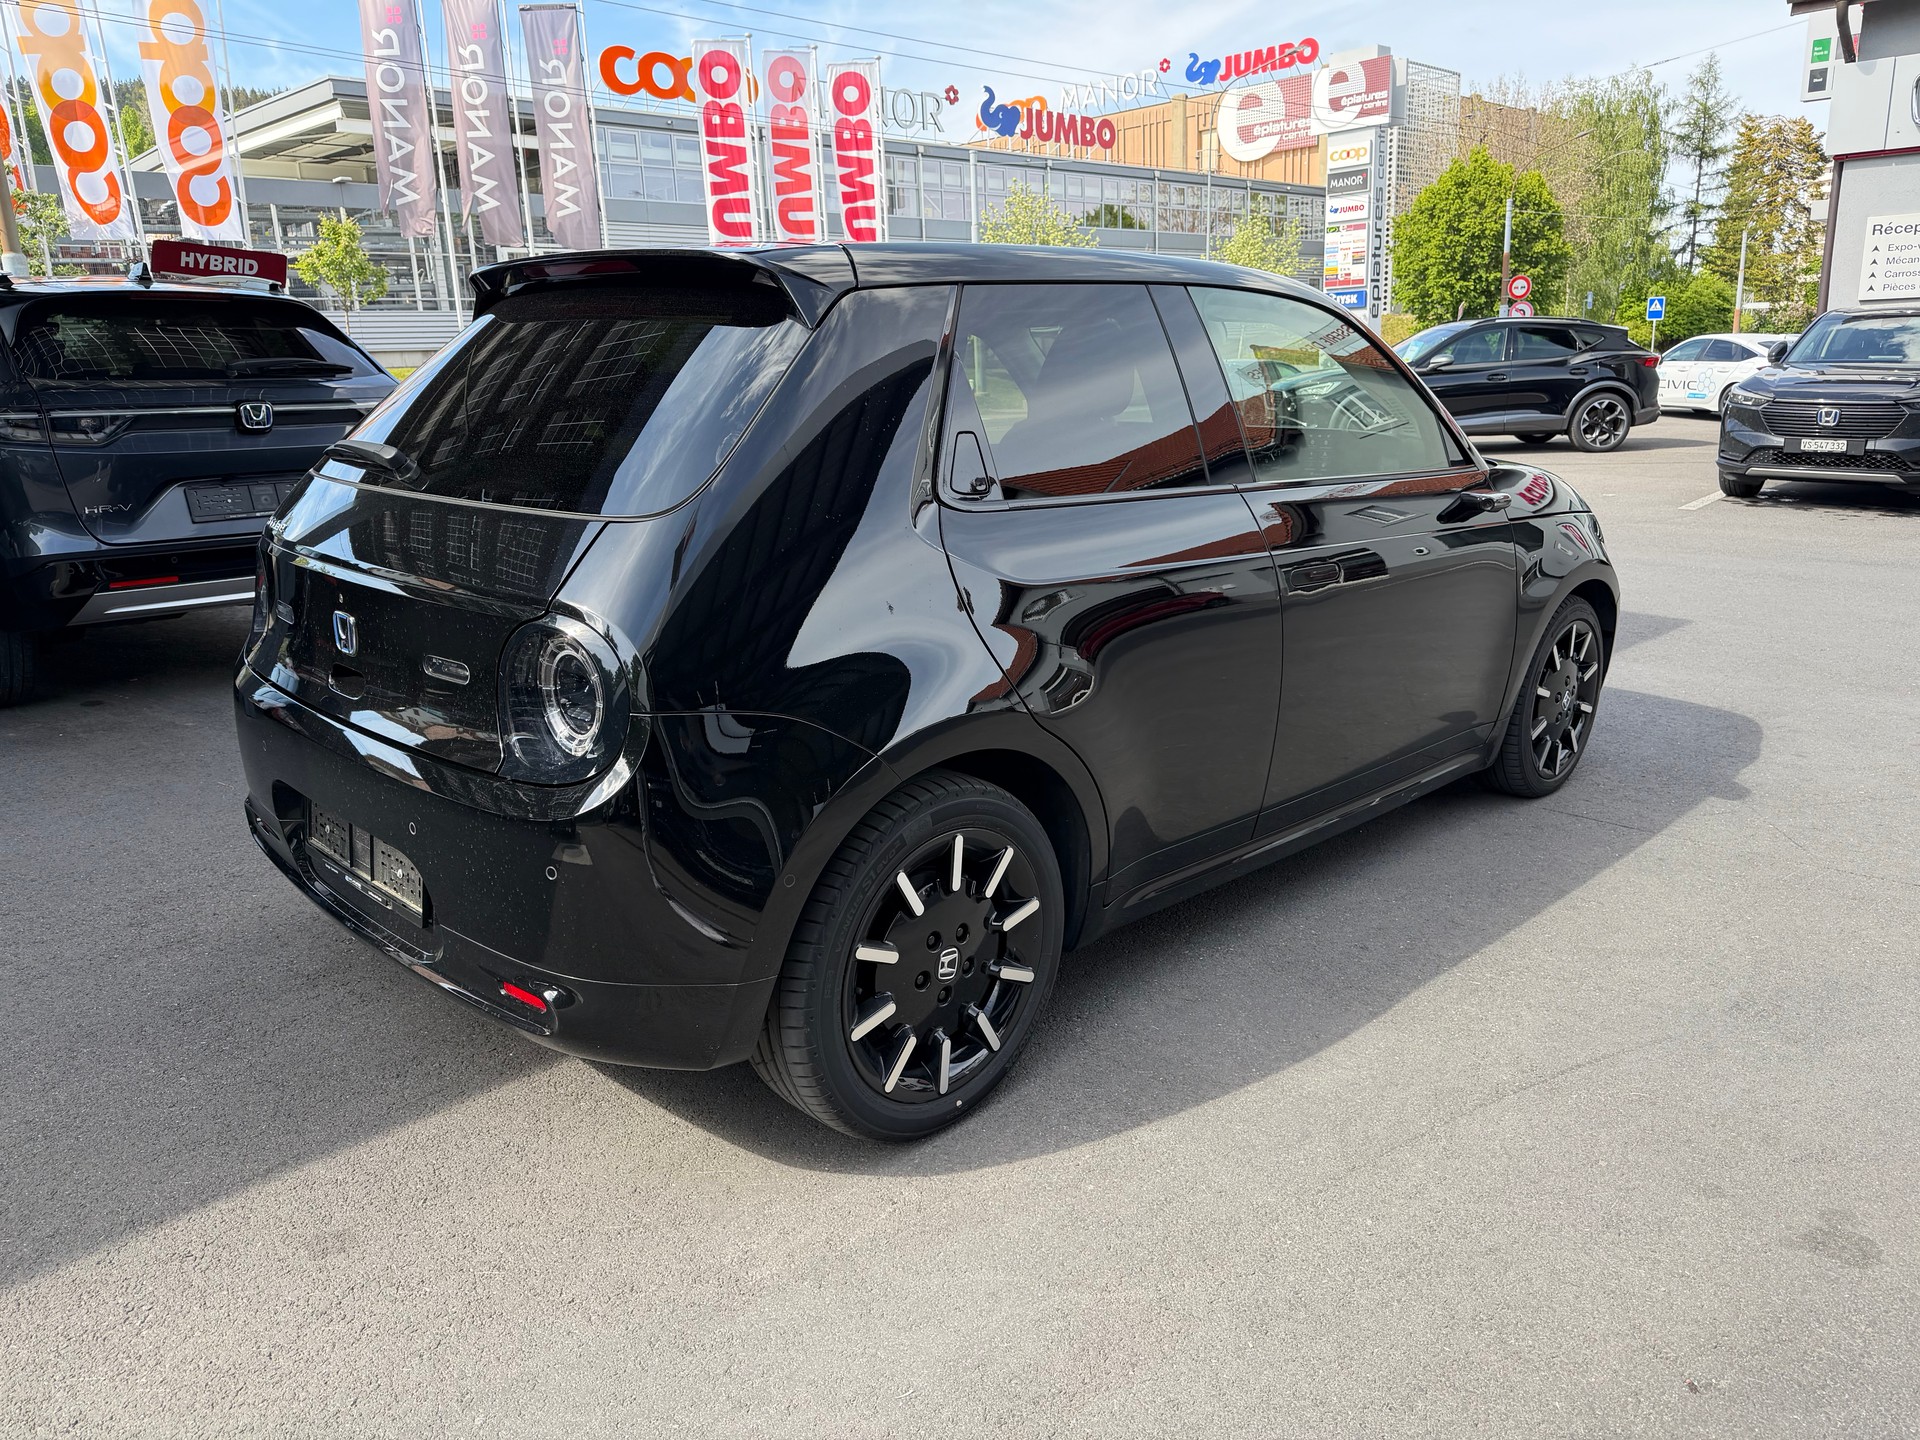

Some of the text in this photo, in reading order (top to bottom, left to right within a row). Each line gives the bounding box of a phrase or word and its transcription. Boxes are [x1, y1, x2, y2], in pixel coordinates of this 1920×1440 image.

[1219, 37, 1320, 81] JUMBO
[1060, 68, 1159, 111] MANOR
[1020, 107, 1116, 149] JUMBO
[1330, 147, 1368, 162] coop
[1330, 176, 1363, 188] MANOR
[1339, 204, 1364, 214] JUMBO
[180, 251, 258, 275] HYBRID
[1882, 282, 1916, 292] Pièces
[84, 502, 133, 516] HR-V
